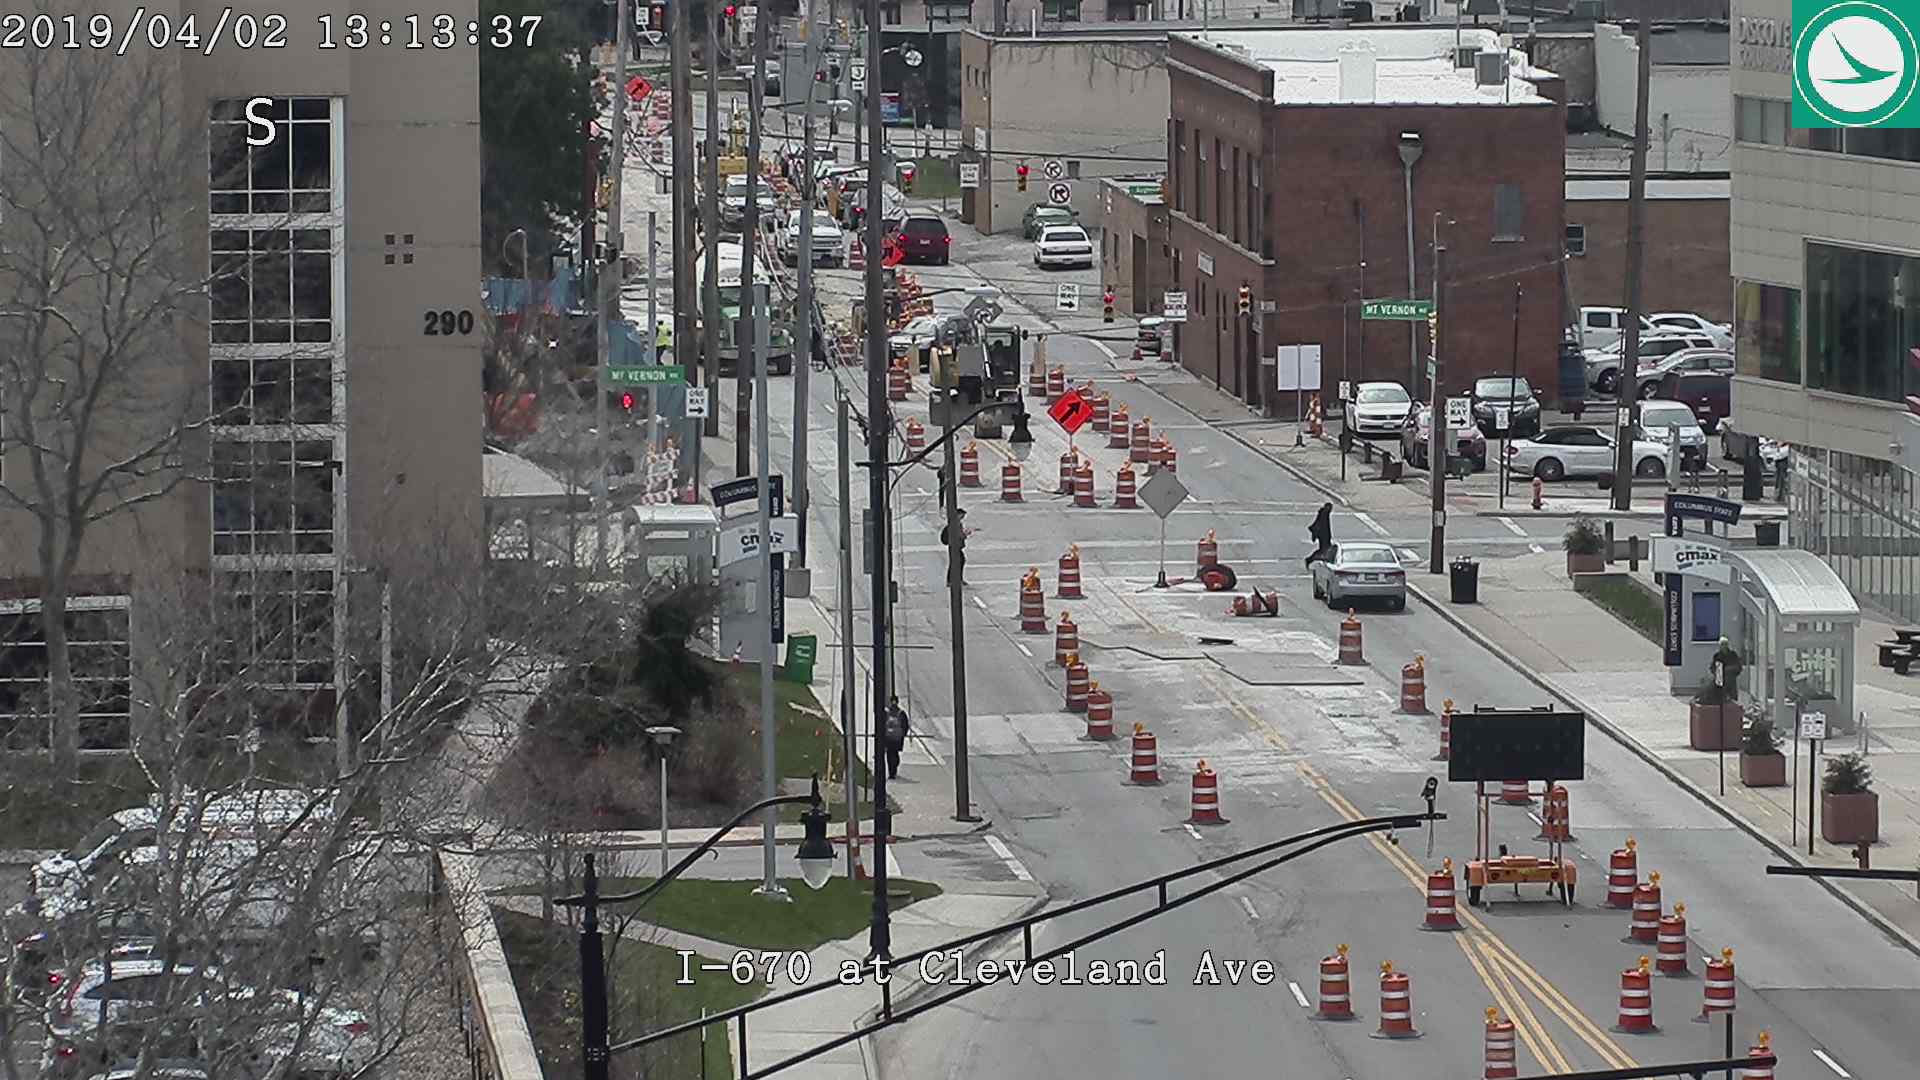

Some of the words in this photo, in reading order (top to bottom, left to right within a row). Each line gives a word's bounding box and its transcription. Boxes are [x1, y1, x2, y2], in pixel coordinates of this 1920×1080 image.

[1366, 304, 1378, 314] MT
[1380, 304, 1416, 315] VERNON
[423, 308, 474, 336] 290
[611, 370, 625, 380] MT
[628, 370, 667, 381] VERNON
[1450, 400, 1467, 408] ONE
[1676, 550, 1718, 563] cmax
